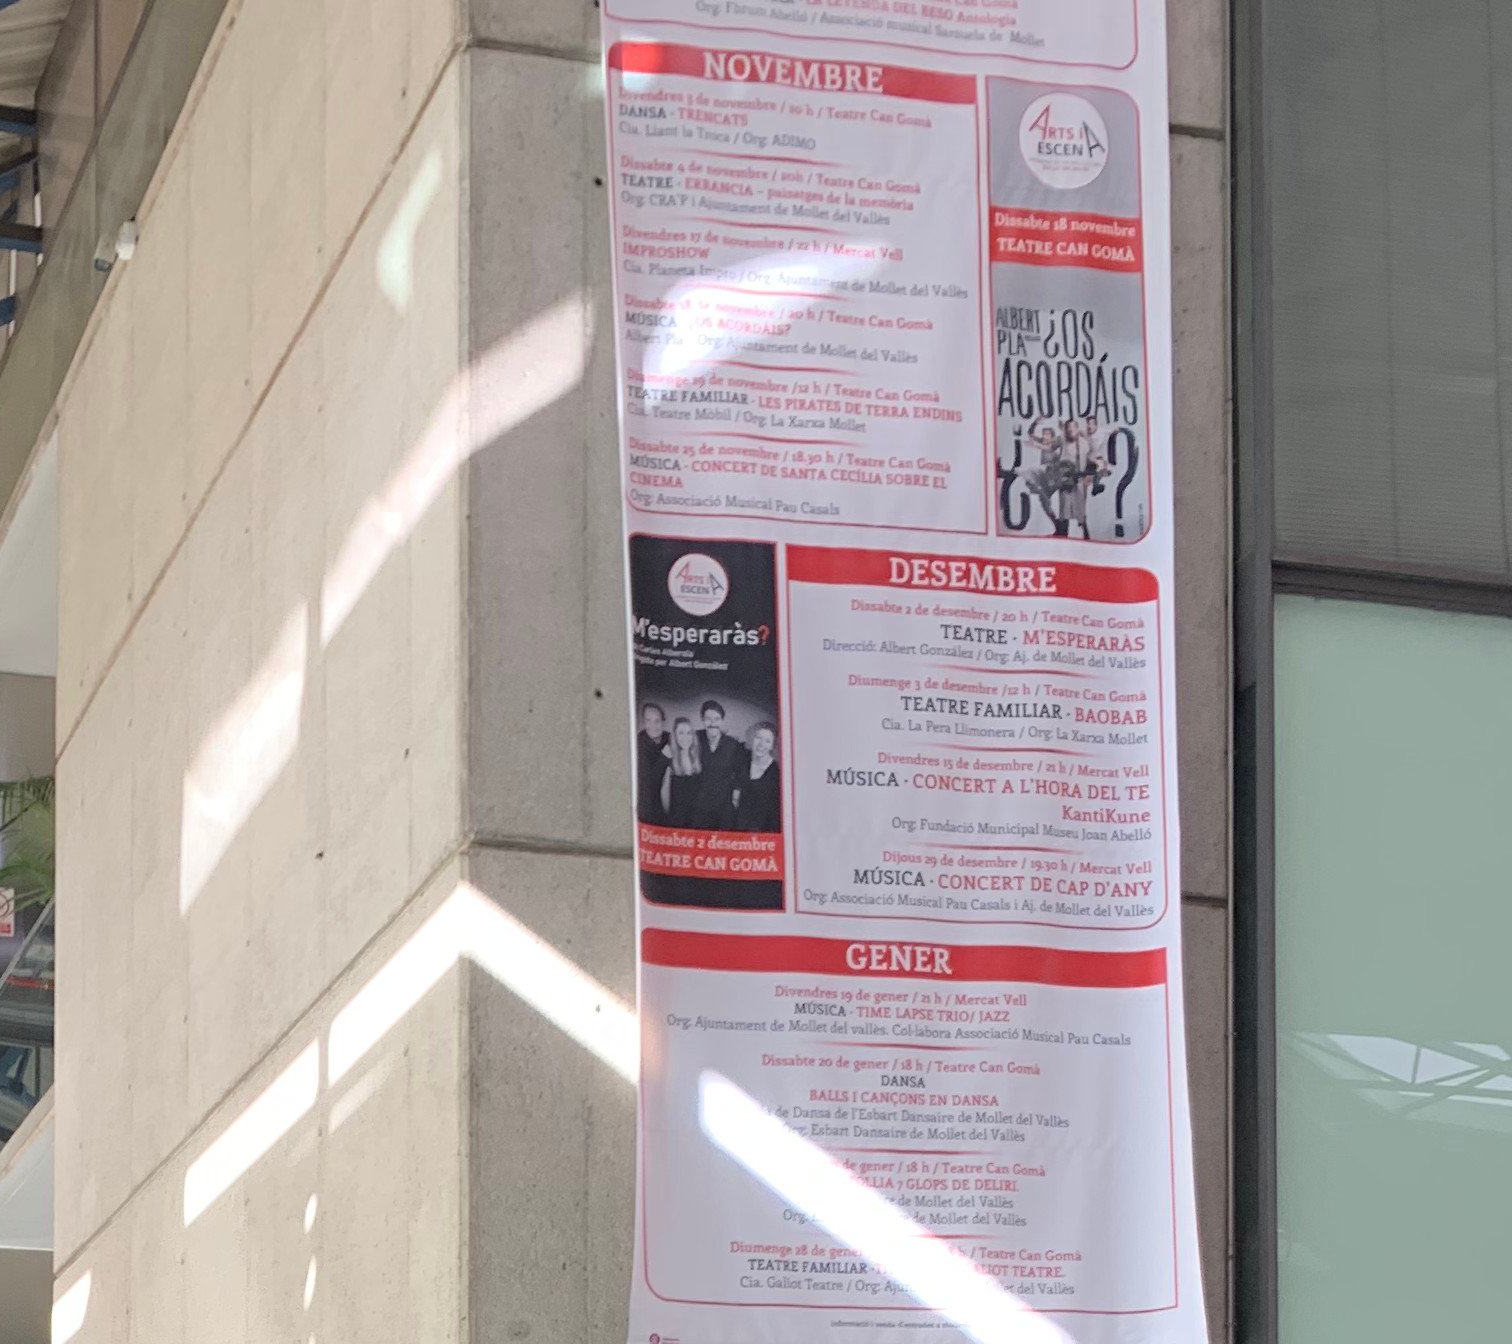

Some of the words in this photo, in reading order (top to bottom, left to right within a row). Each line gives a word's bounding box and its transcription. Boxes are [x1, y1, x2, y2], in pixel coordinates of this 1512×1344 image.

[703, 51, 884, 94] NOVEMBRE
[1028, 103, 1074, 141] ARTS
[1037, 120, 1106, 158] ESCENA
[621, 173, 673, 189] TEATRE
[995, 212, 1050, 232] Dissabte
[1052, 217, 1068, 234] 18
[1071, 218, 1136, 238] novembre
[997, 237, 1053, 256] TEATRE
[1056, 241, 1088, 258] CAN
[1091, 241, 1136, 262] GOMÀ
[625, 312, 677, 327] MÚSICA
[996, 306, 1040, 332] ALBERT
[997, 331, 1028, 357] PLA
[1043, 309, 1095, 361] ¿OS
[997, 353, 1140, 428] ACORDÁIS
[626, 386, 678, 402] TEATRE
[681, 390, 749, 405] FAMILIAR
[759, 396, 781, 409] LES
[786, 398, 841, 413] PIRATES
[845, 401, 861, 415] DE
[866, 404, 908, 418] TERRA
[914, 406, 962, 423] ENDINS
[629, 471, 684, 488] CINEMA
[630, 454, 681, 471] MÚSICA
[691, 460, 758, 474] CONCERT
[760, 464, 778, 478] DE
[780, 466, 827, 480] SANTA
[830, 468, 883, 485] CECÍLIA
[886, 473, 930, 487] SOBRE
[932, 476, 948, 490] EL
[889, 557, 1057, 593] DESEMBRE
[851, 599, 903, 614] Dissabte
[905, 606, 912, 615] 2
[914, 604, 929, 616] de
[932, 604, 990, 621] desembre
[1002, 613, 1016, 622] 20
[1020, 610, 1028, 622] h
[1041, 611, 1080, 625] Teatre
[1081, 614, 1104, 628] Can
[1107, 617, 1144, 629] Gomà
[940, 624, 1007, 645] TEATRE
[1022, 629, 1145, 652] M'ESPERARÀS
[848, 674, 912, 691] Diumenge
[914, 680, 922, 691] 3
[924, 678, 940, 689] de
[941, 679, 998, 695] desembre
[1022, 684, 1031, 695] h
[1043, 685, 1081, 699] Teatre
[1082, 688, 1106, 701] Can
[1109, 690, 1147, 703] Gomà
[900, 695, 969, 716] TEATRE
[974, 701, 1062, 720] FAMILIAR
[1075, 707, 1147, 725] BAOBAB
[878, 751, 940, 767] Divendres
[943, 759, 954, 770] 15
[956, 757, 970, 770] de
[973, 758, 1034, 771] desembre
[1045, 763, 1056, 773] 21
[1059, 761, 1066, 774] h
[1077, 764, 1119, 778] Mercat
[1122, 765, 1149, 778] Vell
[827, 769, 899, 787] MÚSICA
[913, 773, 996, 794] CONCERT
[1002, 779, 1014, 794] A
[1020, 778, 1082, 799] L'HORA
[1088, 784, 1120, 801] DEL
[1125, 784, 1149, 801] TE
[1062, 805, 1150, 824] KantiKune
[641, 829, 695, 848] Dissabte
[697, 839, 705, 849] 2
[707, 835, 776, 852] desembre
[640, 848, 691, 869] TEATRE
[694, 855, 727, 871] CAN
[729, 856, 778, 873] GOMÀ
[853, 869, 925, 887] MÚSICA
[938, 874, 1025, 891] CONCERT
[1030, 876, 1052, 893] DE
[1056, 879, 1089, 896] CAP
[1094, 880, 1153, 898] D'ANY
[845, 944, 953, 975] GENER
[774, 985, 838, 999] Divendres
[841, 991, 854, 1003] 19
[855, 989, 871, 1001] de
[873, 992, 909, 1004] gener
[920, 994, 931, 1004] 21
[934, 992, 942, 1004] h
[955, 994, 1000, 1005] Mercat
[1003, 993, 1027, 1007] Vell
[794, 1003, 847, 1017] MÚSICA
[857, 1006, 890, 1018] TIME
[897, 1007, 932, 1021] LAPSE
[938, 1010, 973, 1023] TRIO/
[980, 1010, 1009, 1023] JAZZ
[881, 1074, 925, 1088] DANSA
[809, 1089, 849, 1102] BALLS
[852, 1091, 858, 1103] I
[861, 1091, 925, 1105] CANÇONS
[929, 1094, 947, 1106] EN
[952, 1095, 999, 1107] DANSA
[906, 1179, 948, 1191] GLOPS
[952, 1179, 970, 1191] DE
[748, 1258, 798, 1273] TEATRE
[802, 1261, 867, 1274] FAMILIAR
